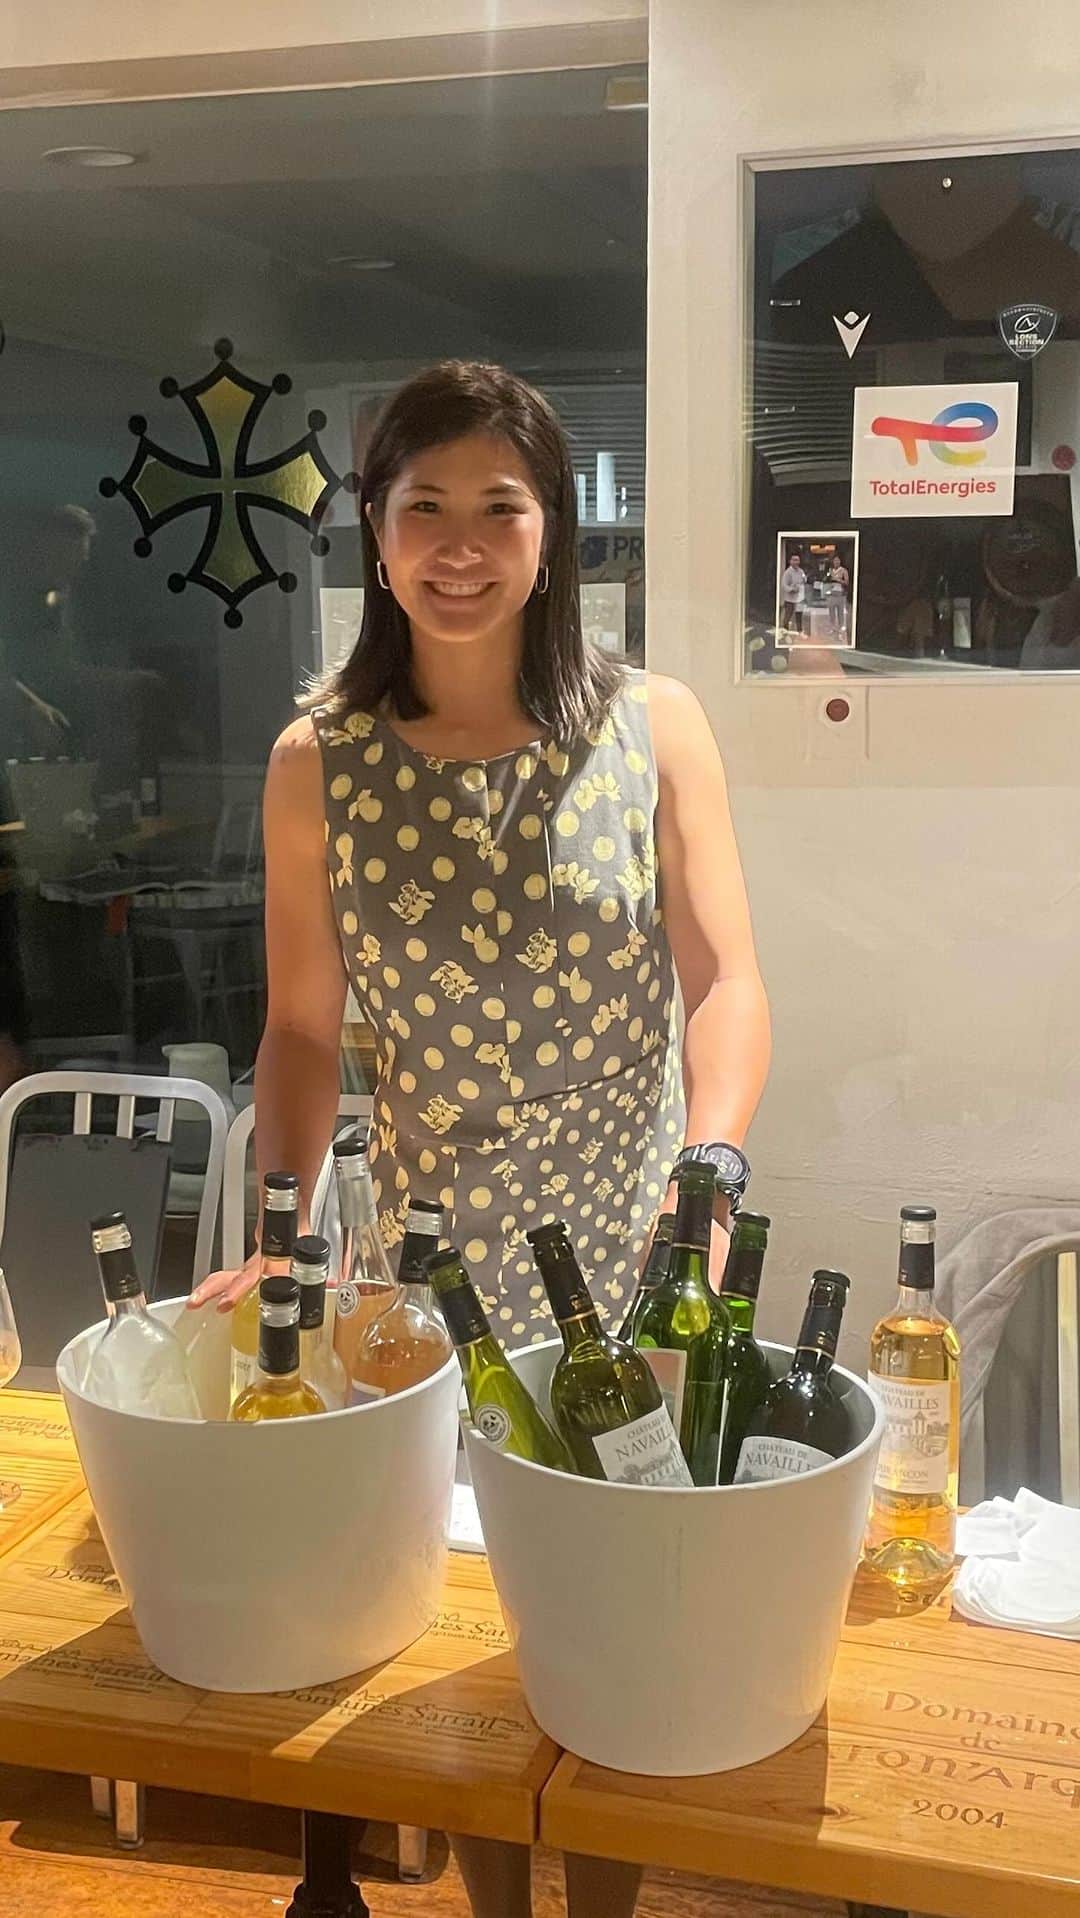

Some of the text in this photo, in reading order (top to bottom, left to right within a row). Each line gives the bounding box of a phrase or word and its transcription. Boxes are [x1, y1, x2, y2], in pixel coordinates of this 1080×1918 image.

[869, 478, 996, 498] TotalEnergies
[408, 1704, 497, 1731] Sarrail
[959, 1731, 1001, 1751] de
[910, 1799, 1007, 1829] 2004
